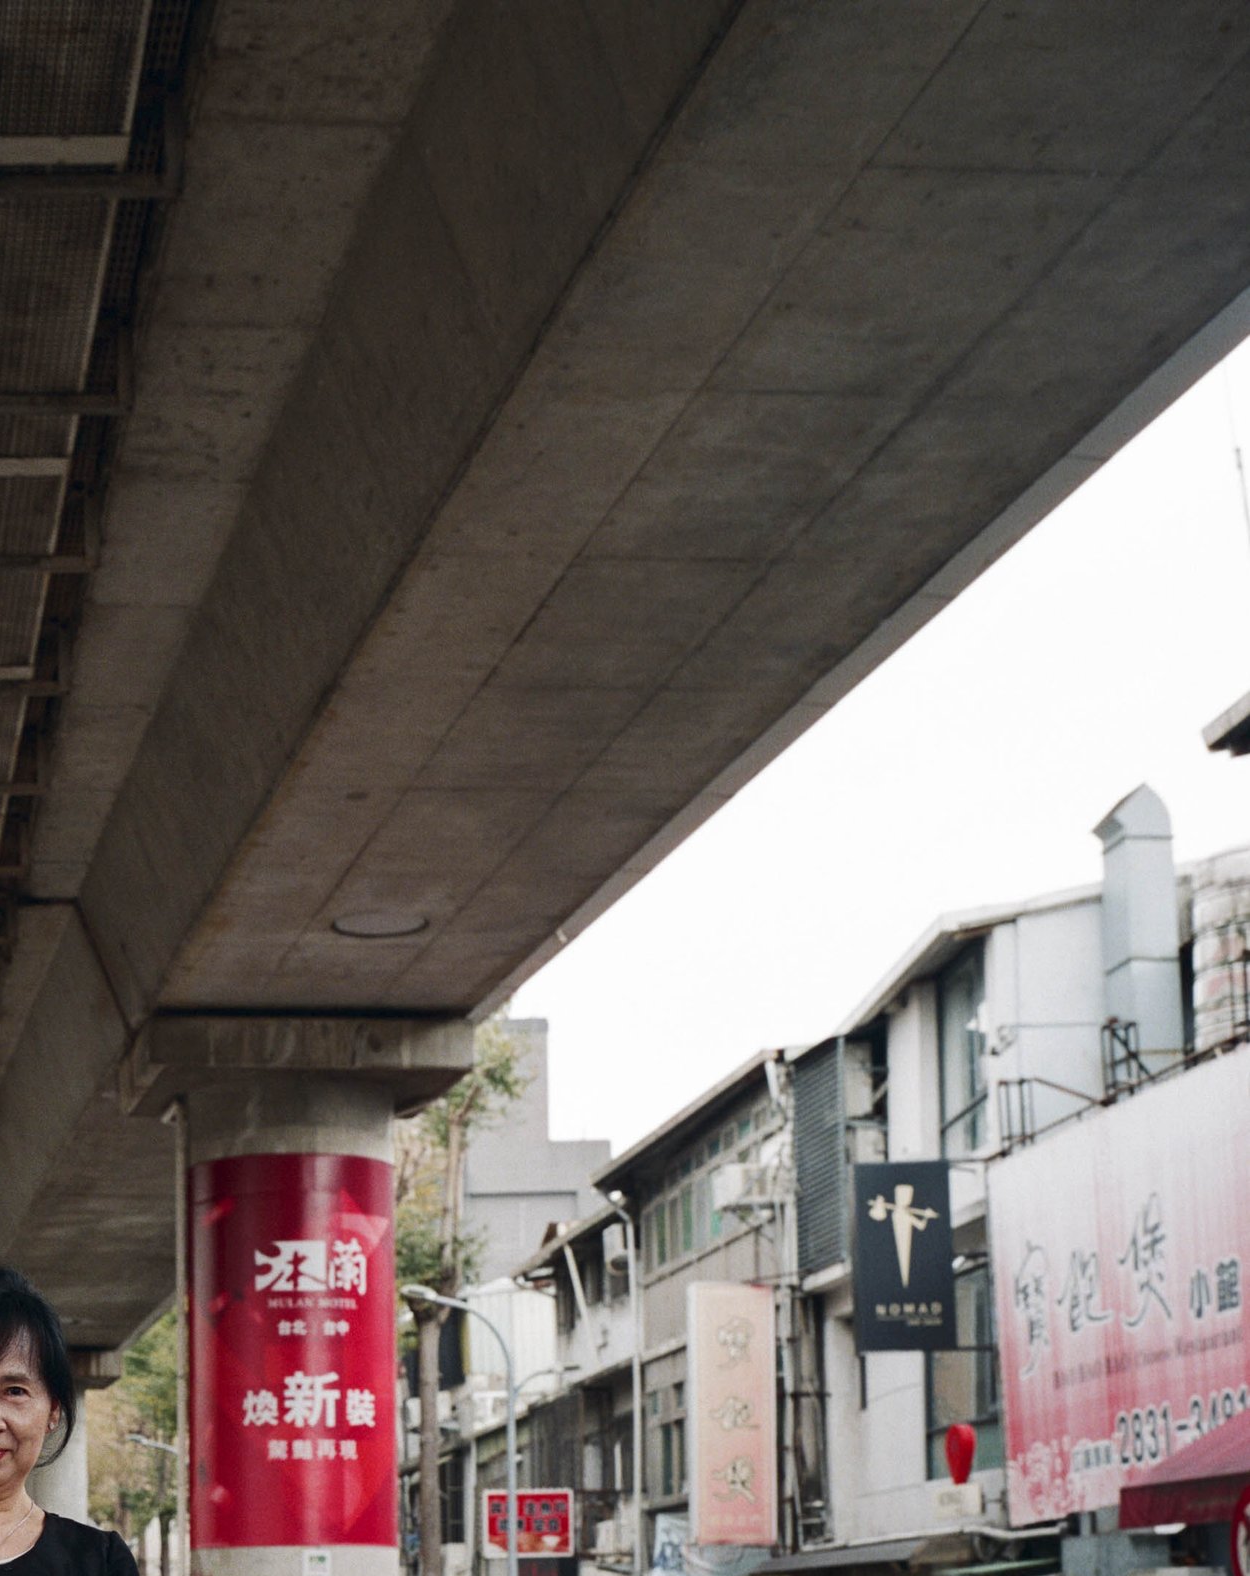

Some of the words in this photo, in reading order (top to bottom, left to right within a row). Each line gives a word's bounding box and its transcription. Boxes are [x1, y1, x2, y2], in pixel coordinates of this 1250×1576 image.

[267, 1298, 313, 1310] MULAN
[318, 1298, 358, 1310] MOTEL
[875, 1302, 942, 1317] NOMAD
